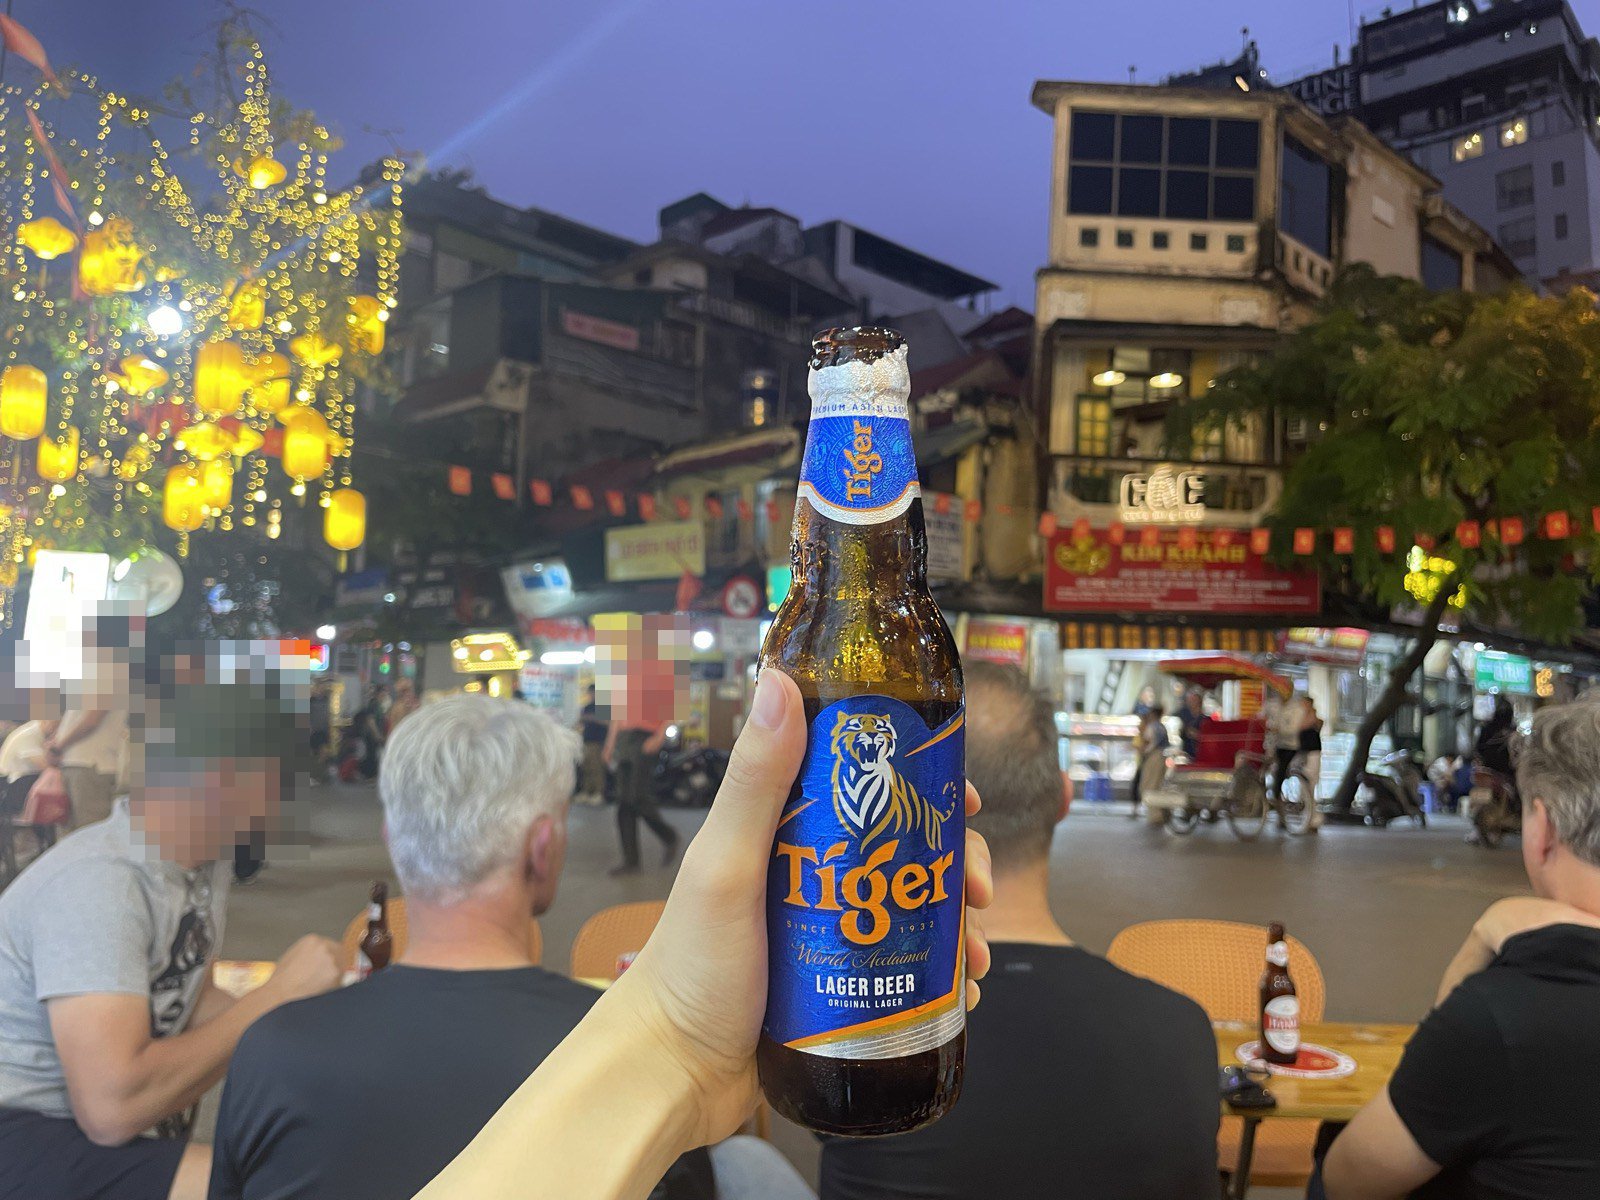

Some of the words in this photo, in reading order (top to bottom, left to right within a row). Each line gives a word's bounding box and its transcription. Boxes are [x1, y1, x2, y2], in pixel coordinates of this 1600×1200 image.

[843, 420, 883, 502] Tiger
[776, 840, 955, 945] Tiger
[786, 920, 827, 935] SINCE
[900, 920, 935, 934] 1932
[791, 941, 850, 967] World
[852, 945, 932, 969] Acclaimed
[816, 974, 869, 996] LAGER
[874, 973, 915, 996] BEER
[828, 998, 871, 1009] ORIGINAL
[874, 997, 903, 1008] LAGER
